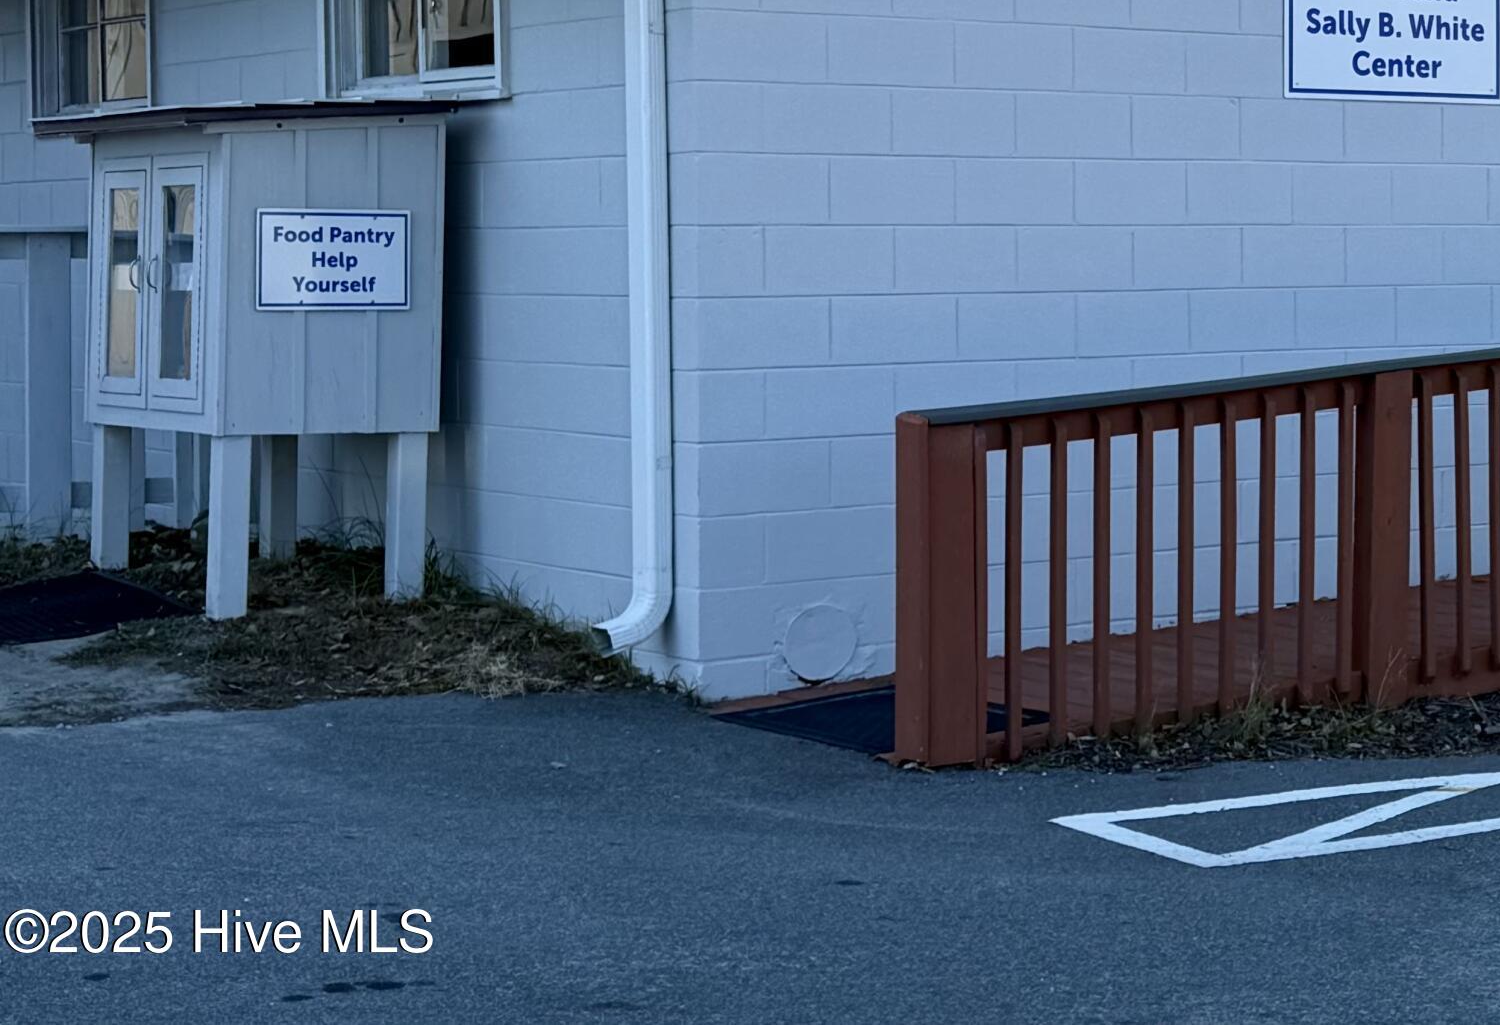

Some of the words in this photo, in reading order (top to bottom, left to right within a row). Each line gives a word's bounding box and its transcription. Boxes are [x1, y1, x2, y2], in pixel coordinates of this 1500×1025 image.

[1306, 8, 1371, 43] Sally
[1378, 12, 1401, 38] B.
[1409, 13, 1484, 42] White
[1352, 50, 1442, 78] Center
[273, 226, 323, 243] Food
[330, 226, 395, 247] Pantry
[312, 251, 358, 272] Help
[293, 276, 376, 293] Yourself
